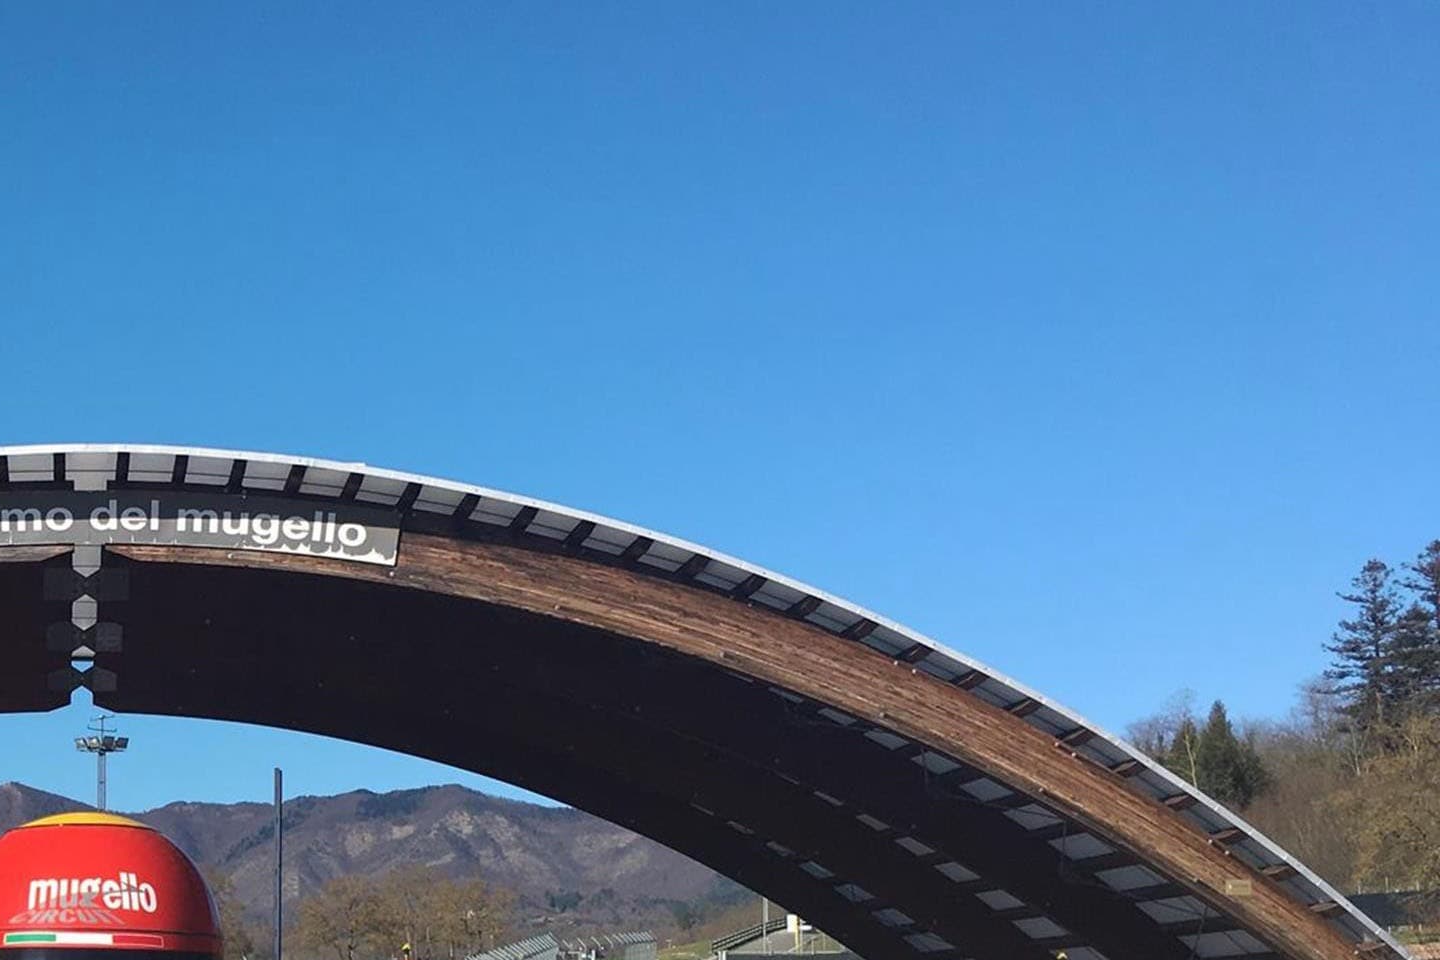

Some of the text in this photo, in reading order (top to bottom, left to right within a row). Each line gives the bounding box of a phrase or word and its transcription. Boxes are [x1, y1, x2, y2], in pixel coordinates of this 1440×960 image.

[90, 500, 159, 531] del
[176, 506, 367, 546] mugello
[28, 871, 158, 913] mugello
